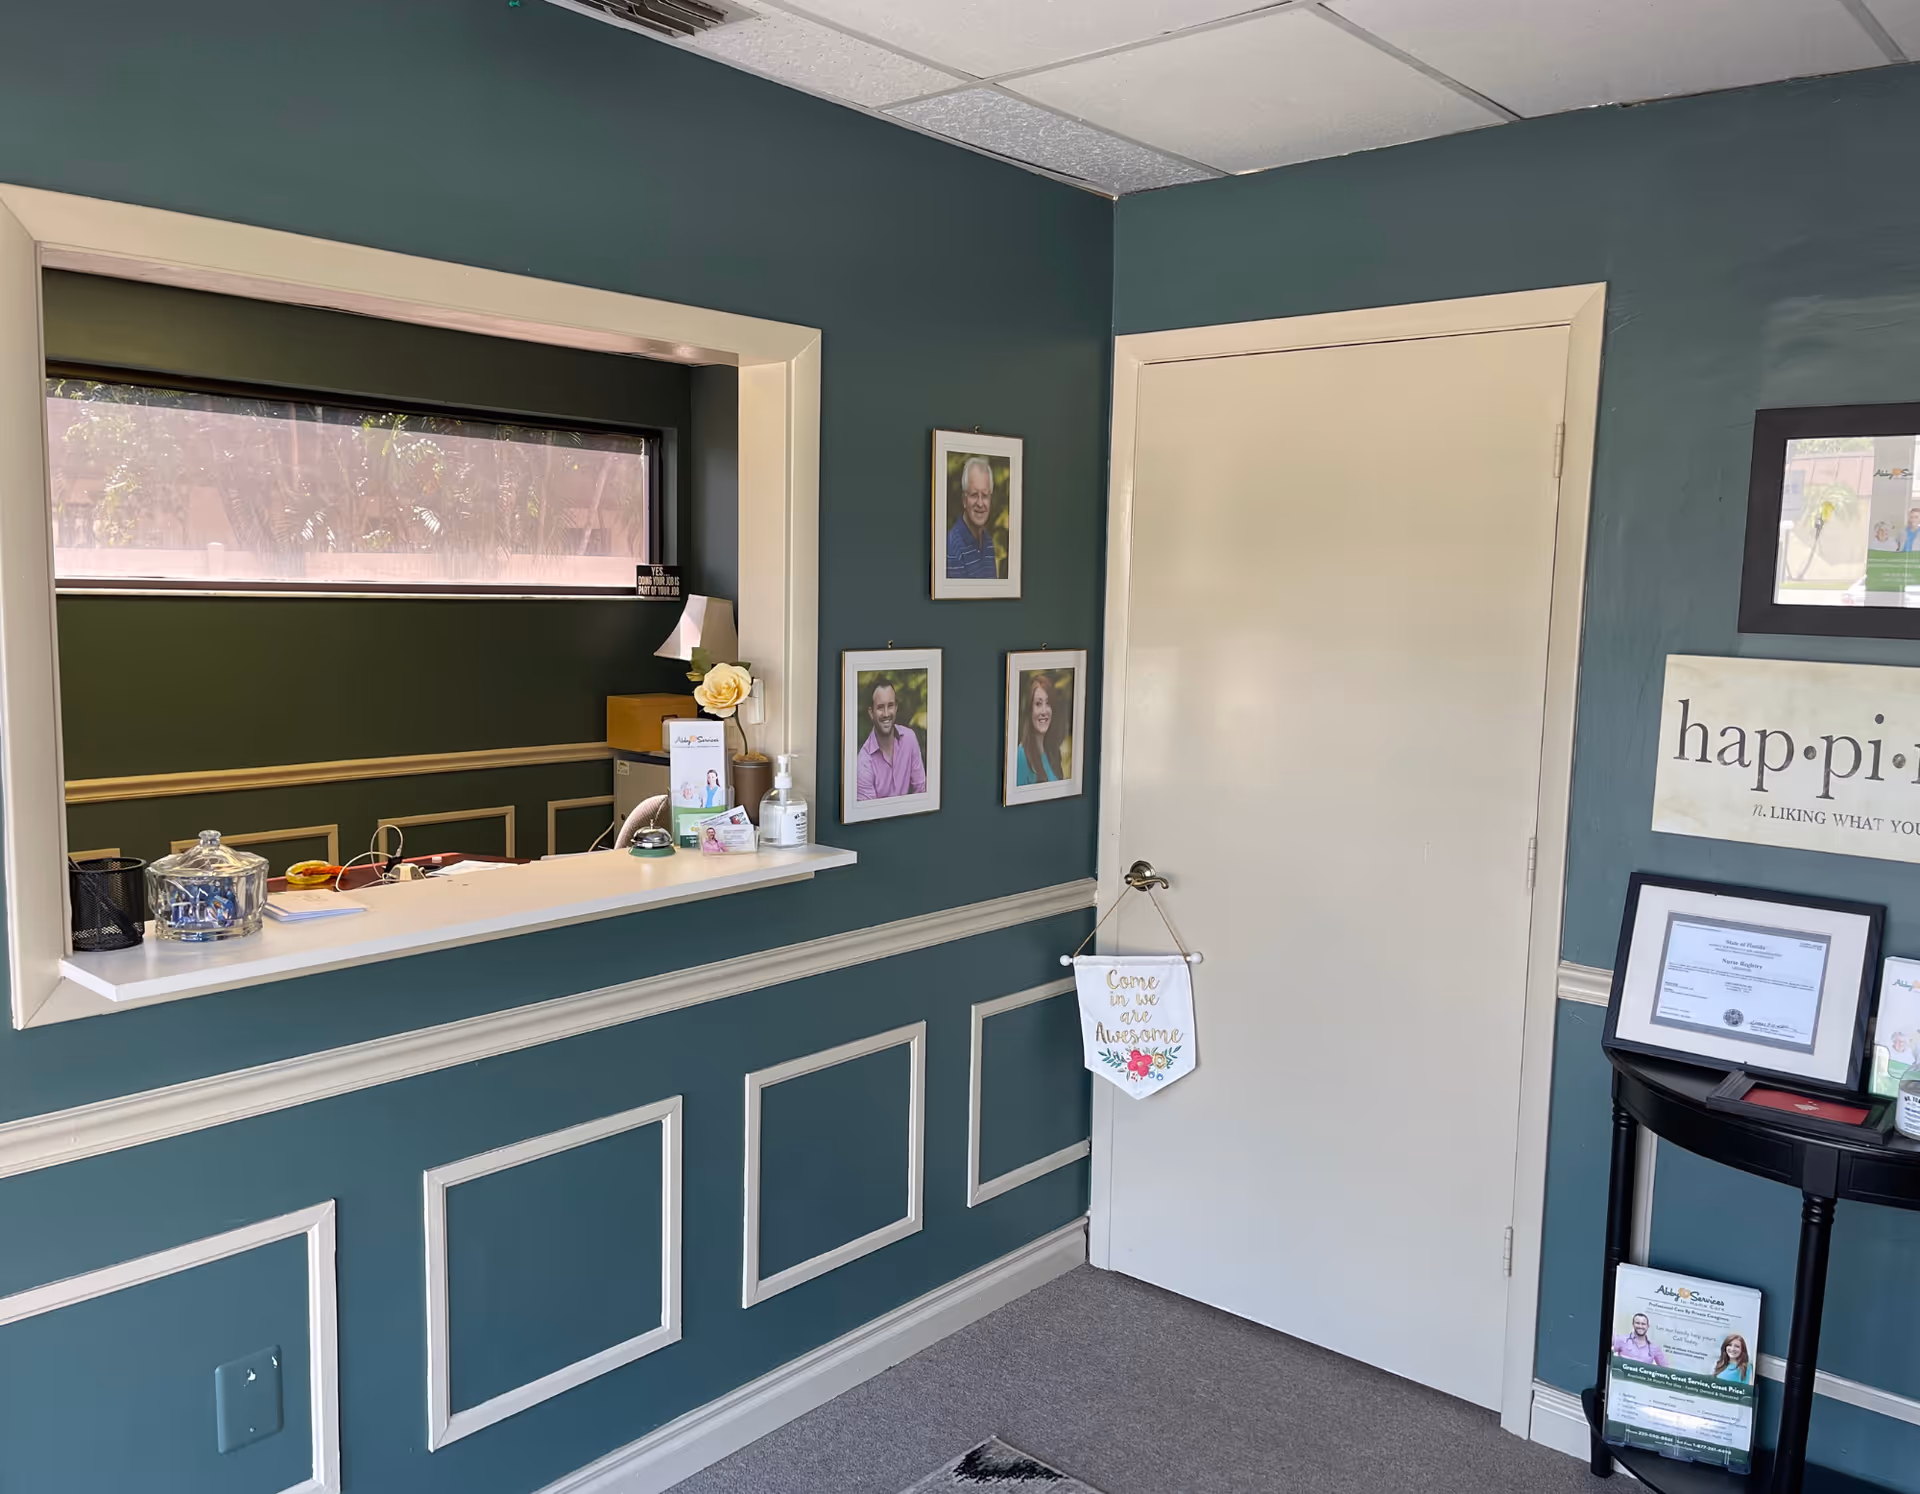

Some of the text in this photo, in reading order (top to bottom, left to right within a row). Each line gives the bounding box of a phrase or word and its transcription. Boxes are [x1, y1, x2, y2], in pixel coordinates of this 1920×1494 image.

[638, 576, 680, 586] DOING YOUR JOB IS
[638, 586, 680, 596] PART OF YOUR JOB
[674, 735, 719, 746] Abby Services
[1770, 806, 1826, 825] LIKING
[1833, 813, 1884, 831] WHAT
[1106, 969, 1160, 991] Come
[1110, 991, 1160, 1007] in we
[1120, 1010, 1152, 1025] are
[1096, 1021, 1184, 1045] Awesome
[1654, 1284, 1725, 1307] Abby Services
[1622, 1363, 1745, 1395] Great Caregivers, Great Service, Great Price!
